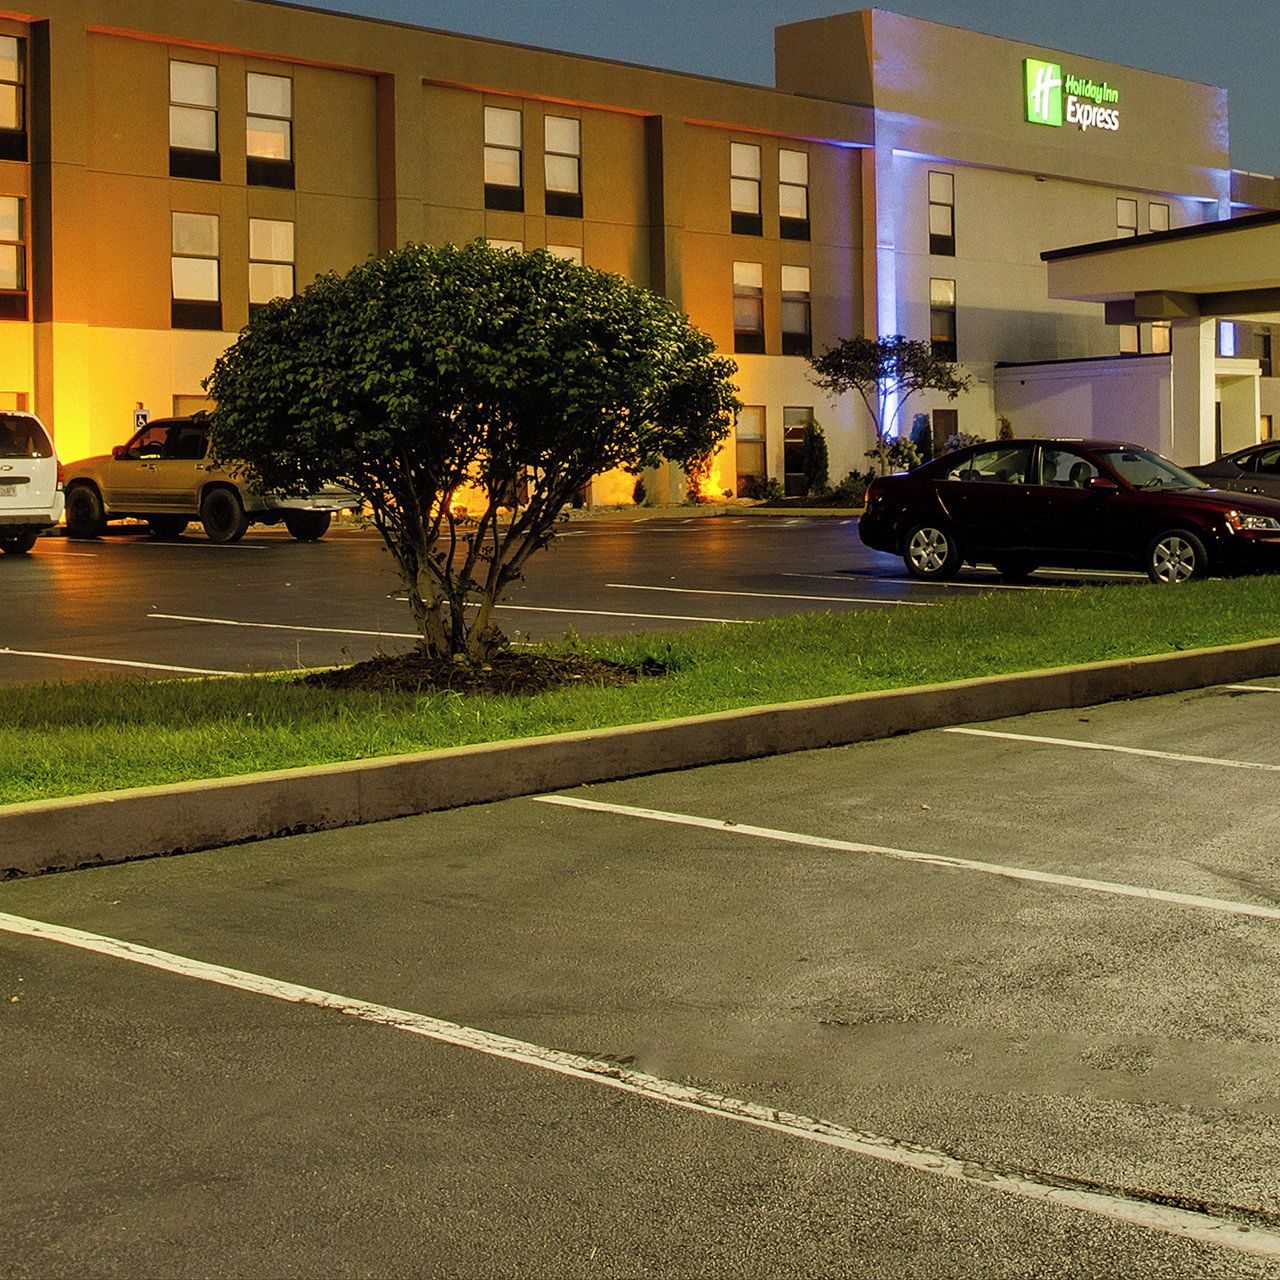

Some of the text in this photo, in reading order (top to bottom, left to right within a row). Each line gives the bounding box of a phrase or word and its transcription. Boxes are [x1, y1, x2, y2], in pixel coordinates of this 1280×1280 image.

[1065, 74, 1103, 104] Holiday
[1103, 82, 1119, 103] Inn
[1066, 95, 1120, 132] Express
